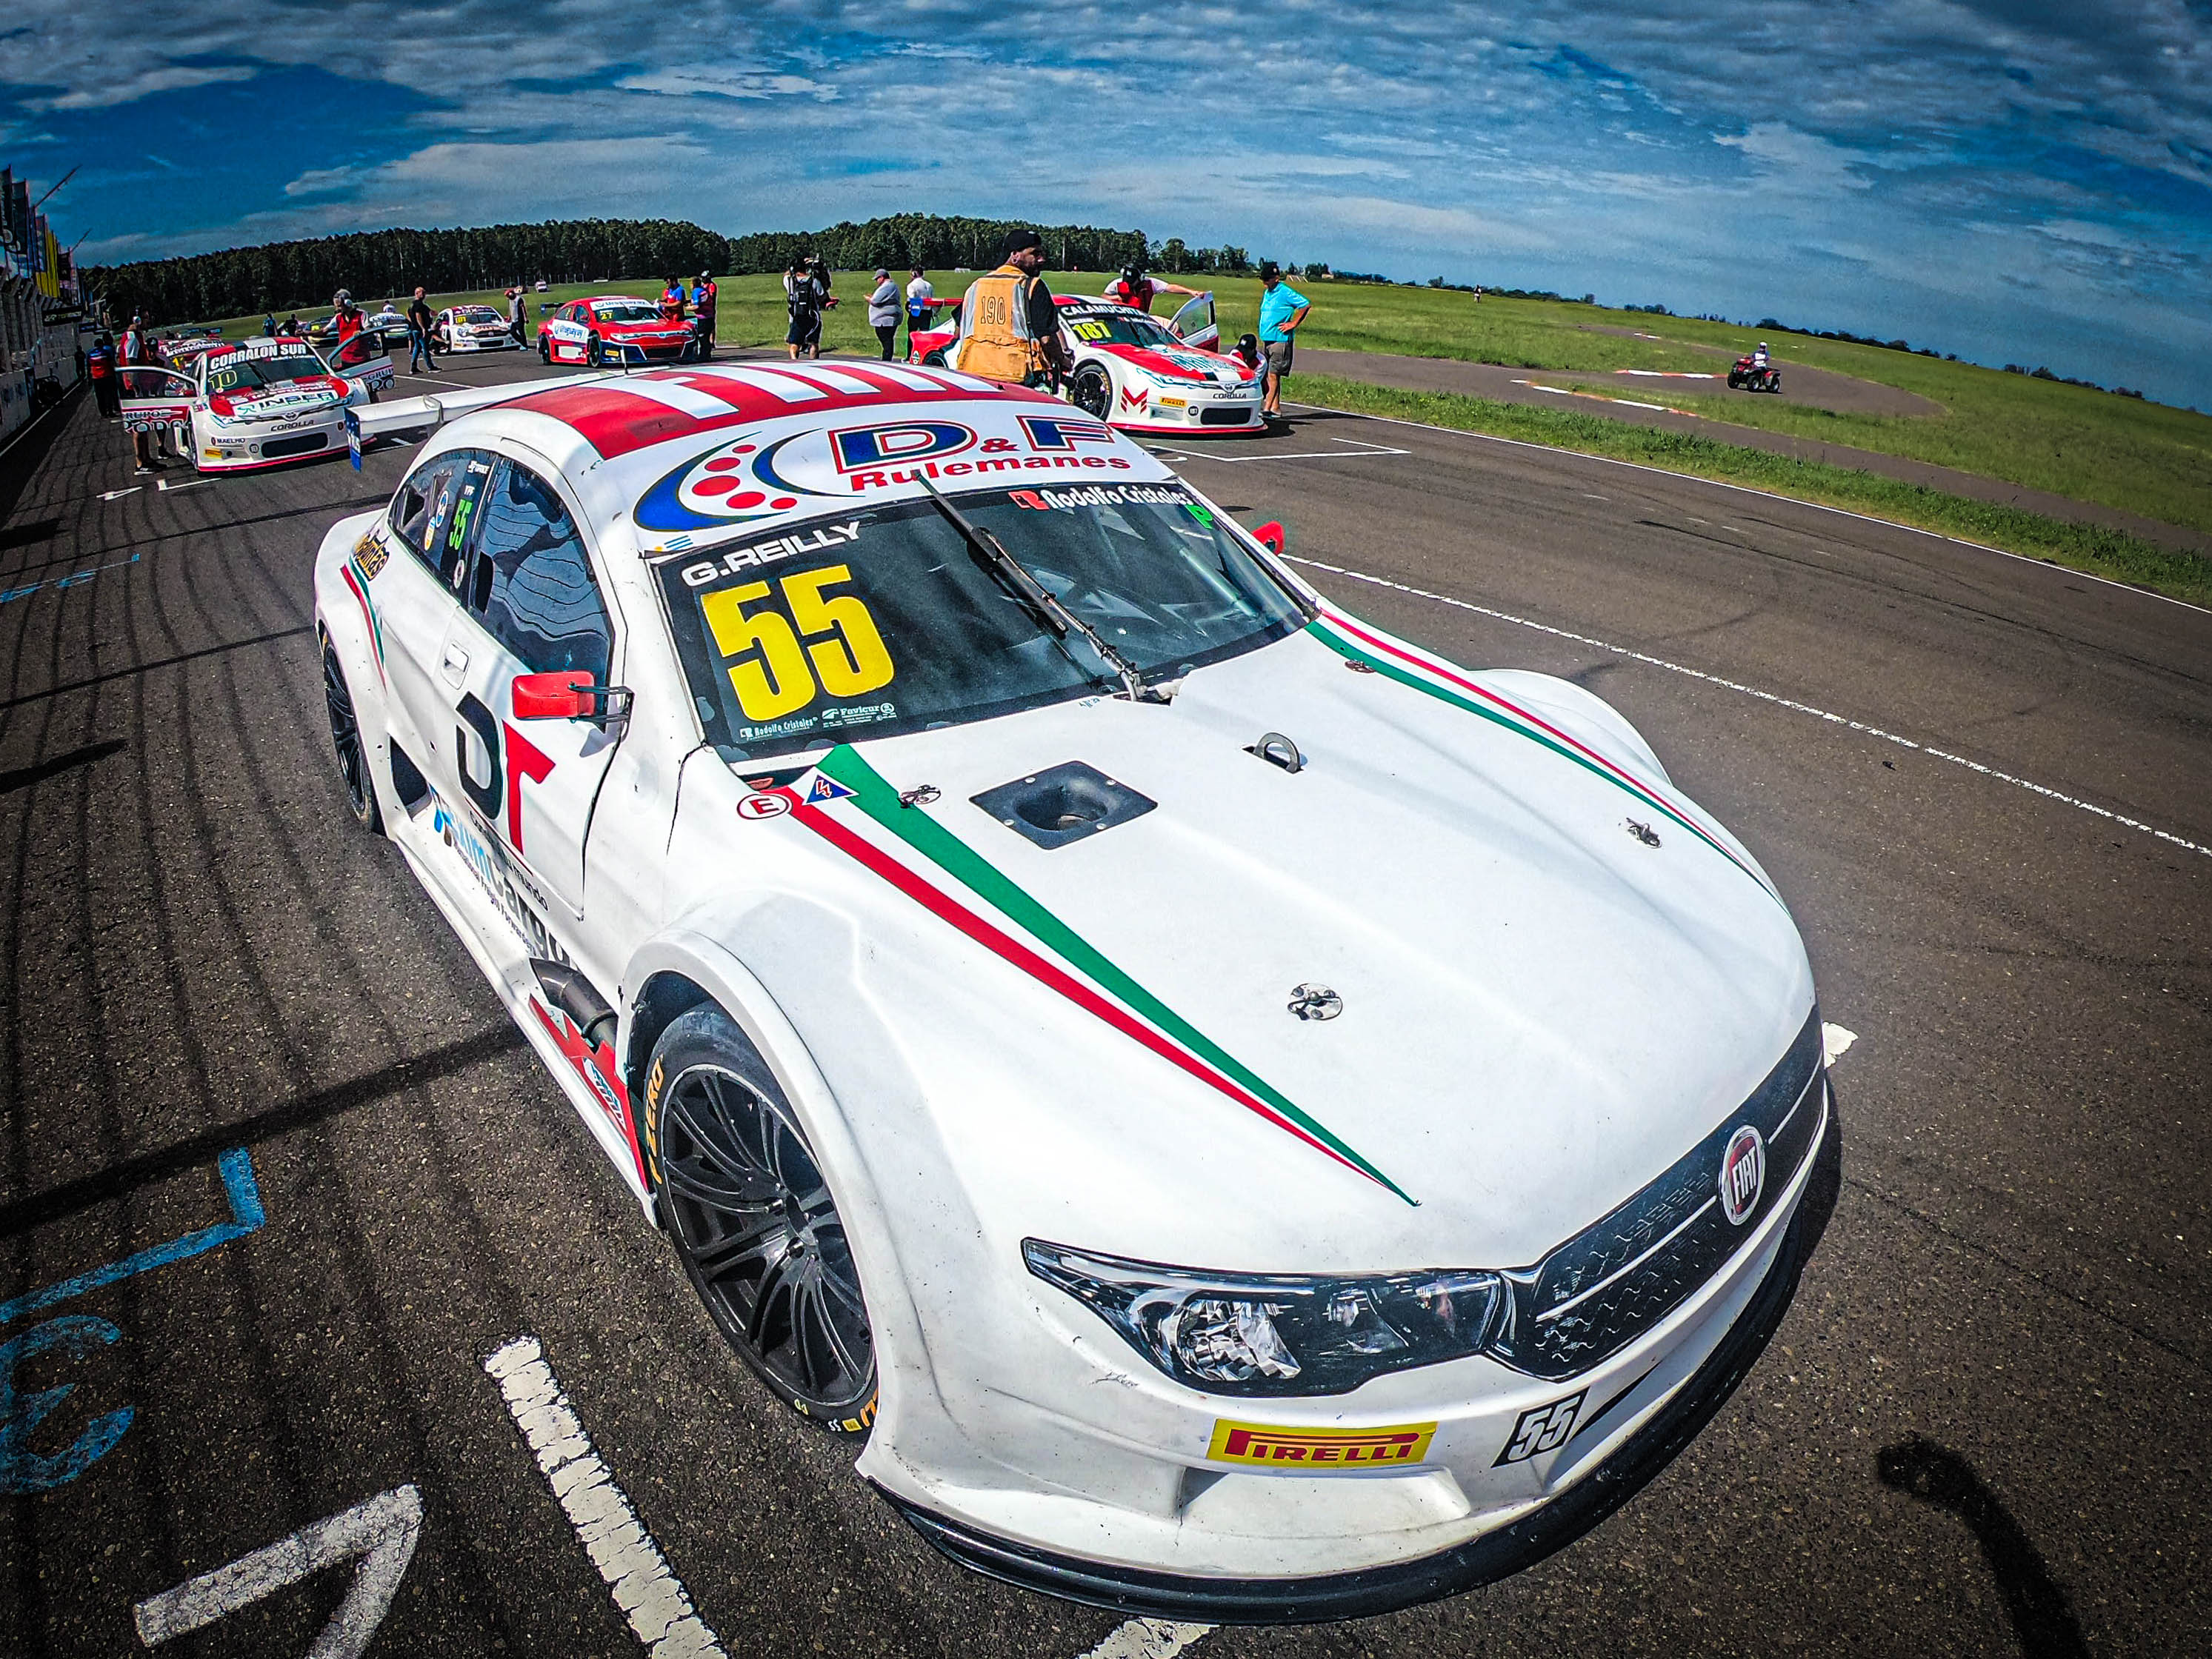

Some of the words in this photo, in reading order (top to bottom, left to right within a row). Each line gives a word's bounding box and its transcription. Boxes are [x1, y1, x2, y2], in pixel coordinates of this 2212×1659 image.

[601, 312, 613, 320] 27
[980, 296, 1005, 324] 190
[1061, 304, 1149, 317] CALAMUCHITA
[1072, 321, 1112, 340] 187
[210, 345, 278, 370] CORRALON
[280, 344, 306, 356] SUR
[208, 370, 237, 389] 10
[270, 420, 315, 432] COROLLA
[850, 455, 1132, 491] Rulemanes
[1040, 486, 1123, 509] Rodolfo
[1118, 485, 1193, 506] Cristales
[449, 498, 473, 550] 55
[682, 521, 860, 587] G.REILLY
[700, 564, 894, 721] 55
[754, 724, 782, 736] Rodolfo
[783, 717, 814, 732] Cristales
[749, 798, 779, 815] E
[645, 1058, 664, 1158] ZERO
[1732, 1146, 1757, 1206] FIAT
[1508, 1395, 1581, 1461] 55
[1224, 1428, 1421, 1462] PIRELLI
